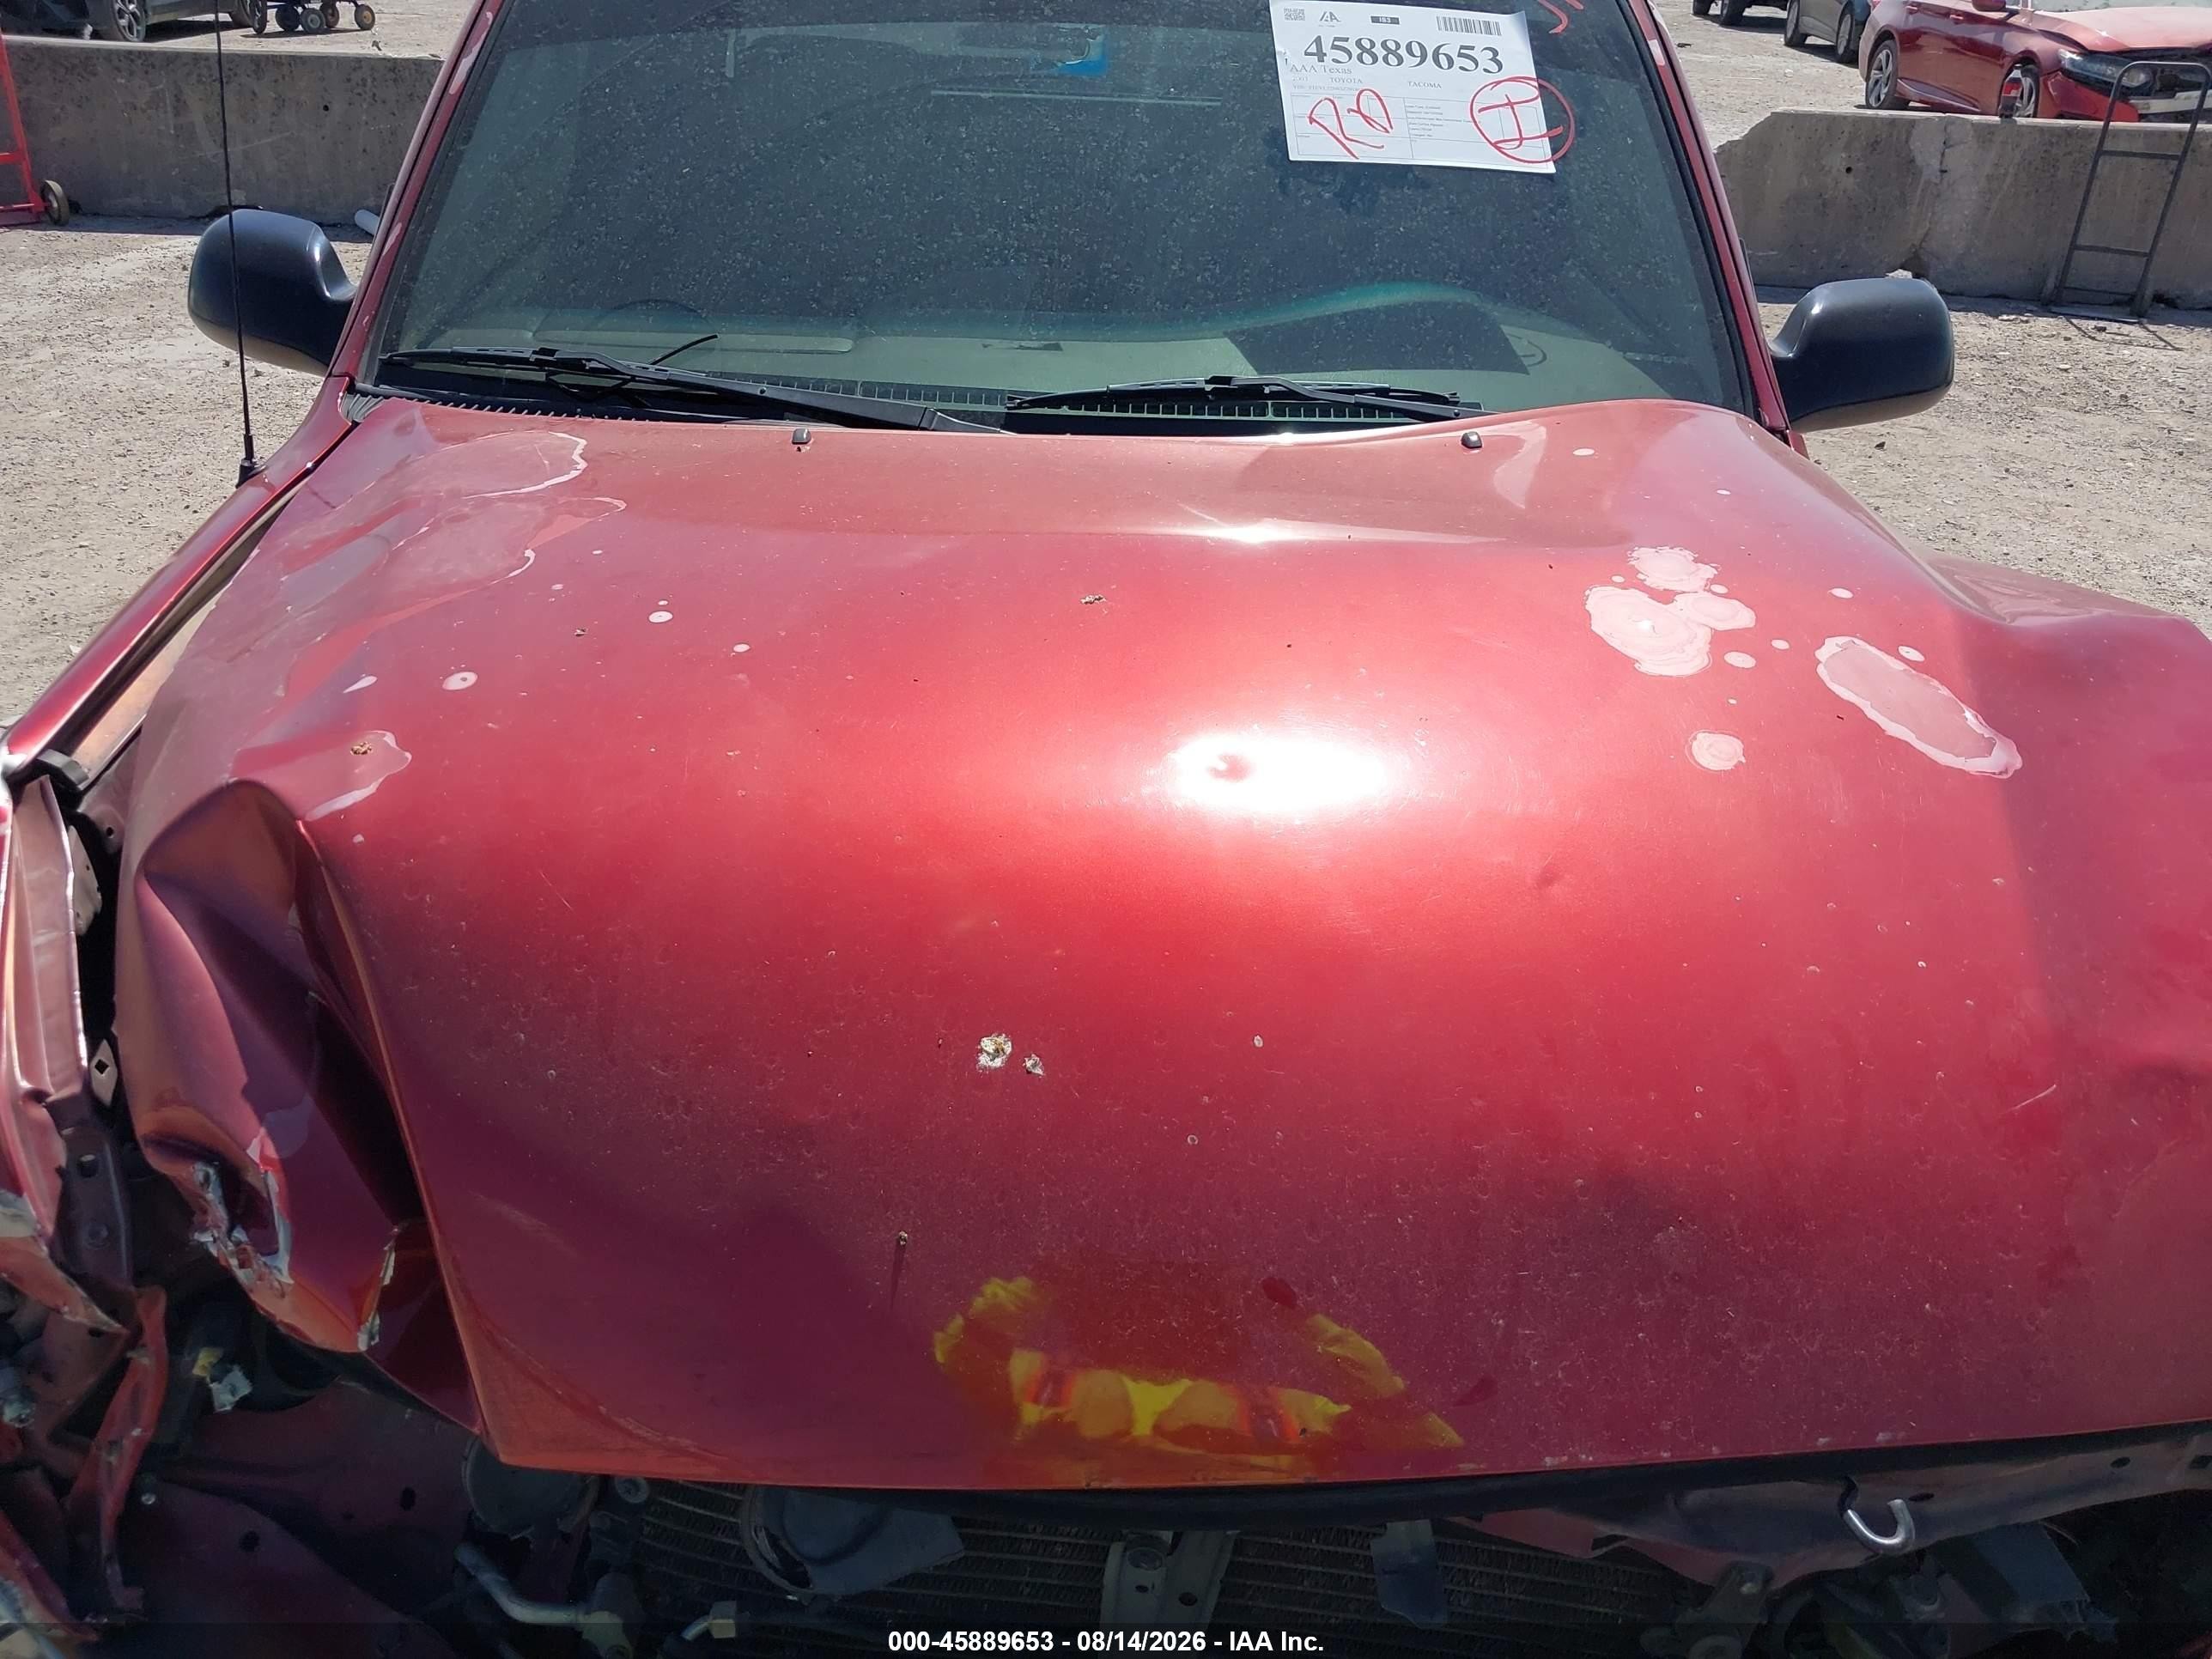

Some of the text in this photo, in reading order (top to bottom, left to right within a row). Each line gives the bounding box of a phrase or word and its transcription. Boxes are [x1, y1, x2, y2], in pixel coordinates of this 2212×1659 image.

[1304, 34, 1504, 74] 45889653
[1290, 64, 1352, 75] AAA Texas
